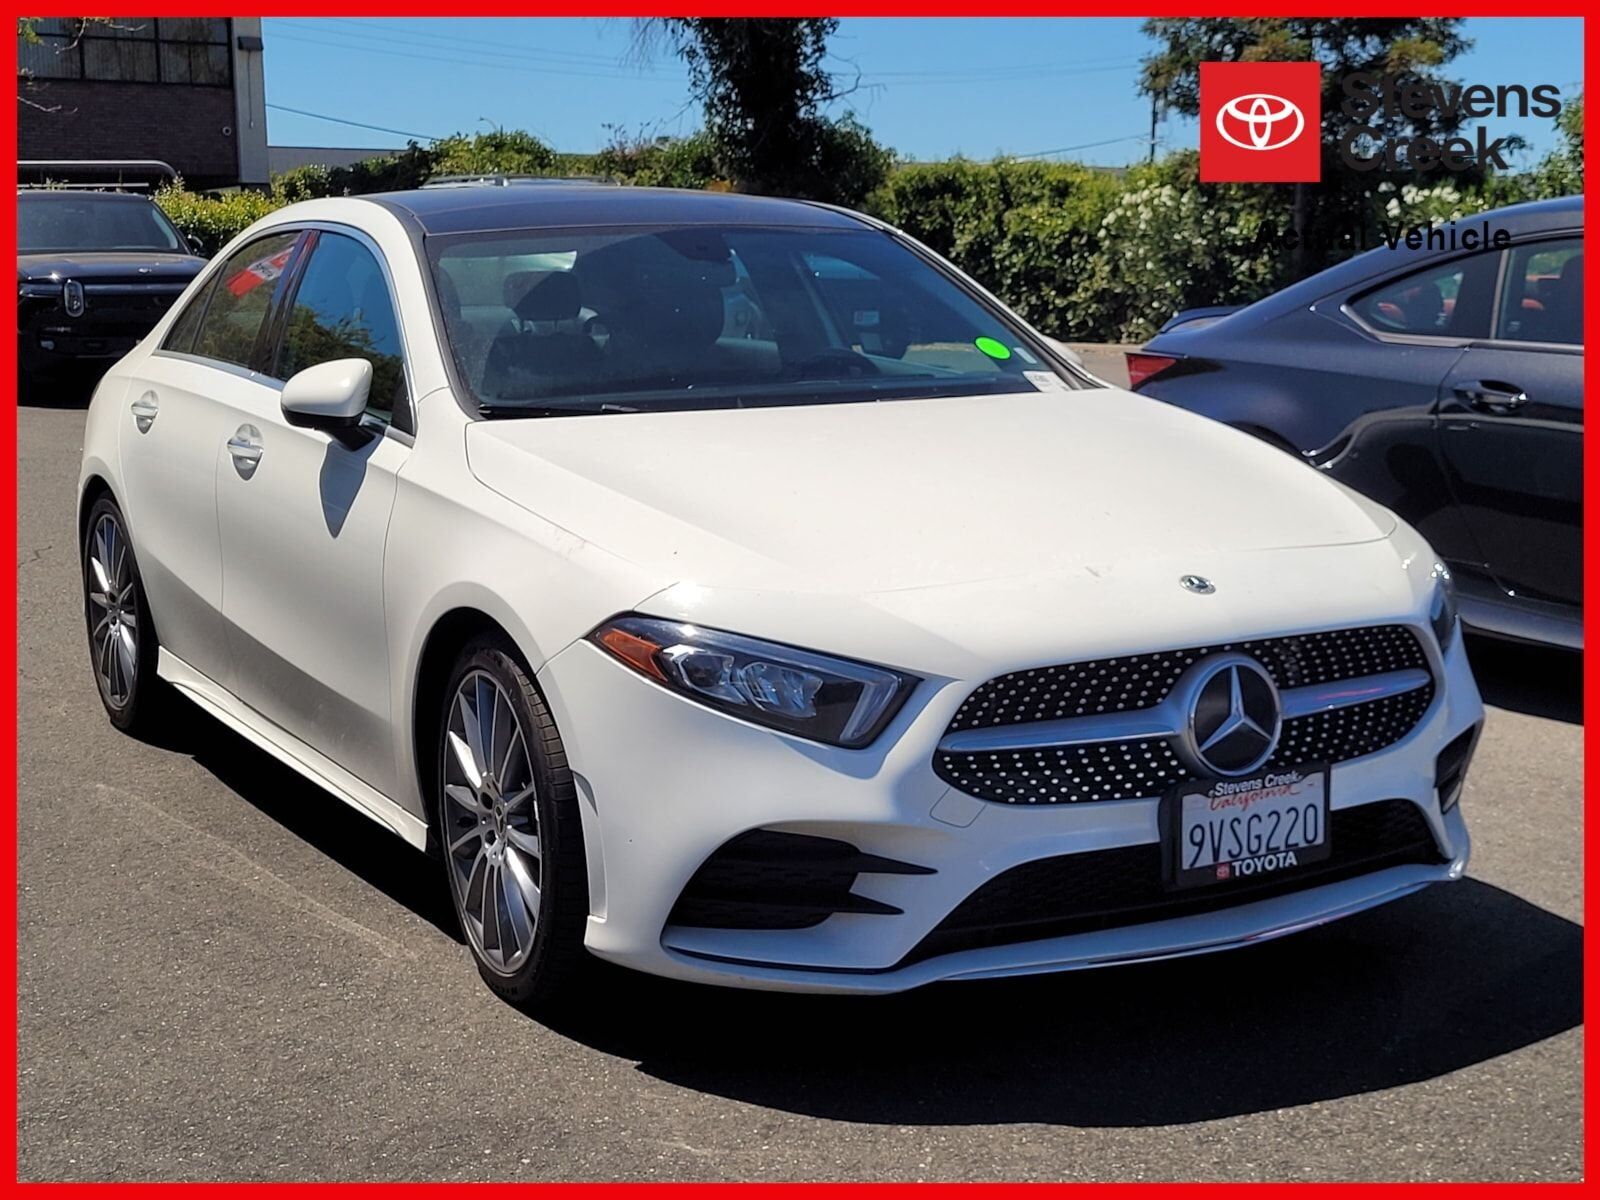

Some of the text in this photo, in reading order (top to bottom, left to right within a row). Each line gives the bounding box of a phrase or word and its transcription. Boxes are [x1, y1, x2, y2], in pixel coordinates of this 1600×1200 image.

[1215, 771, 1299, 796] Stevens Creek
[1189, 803, 1318, 867] 9VSG220
[1232, 851, 1297, 876] TOYOTA
